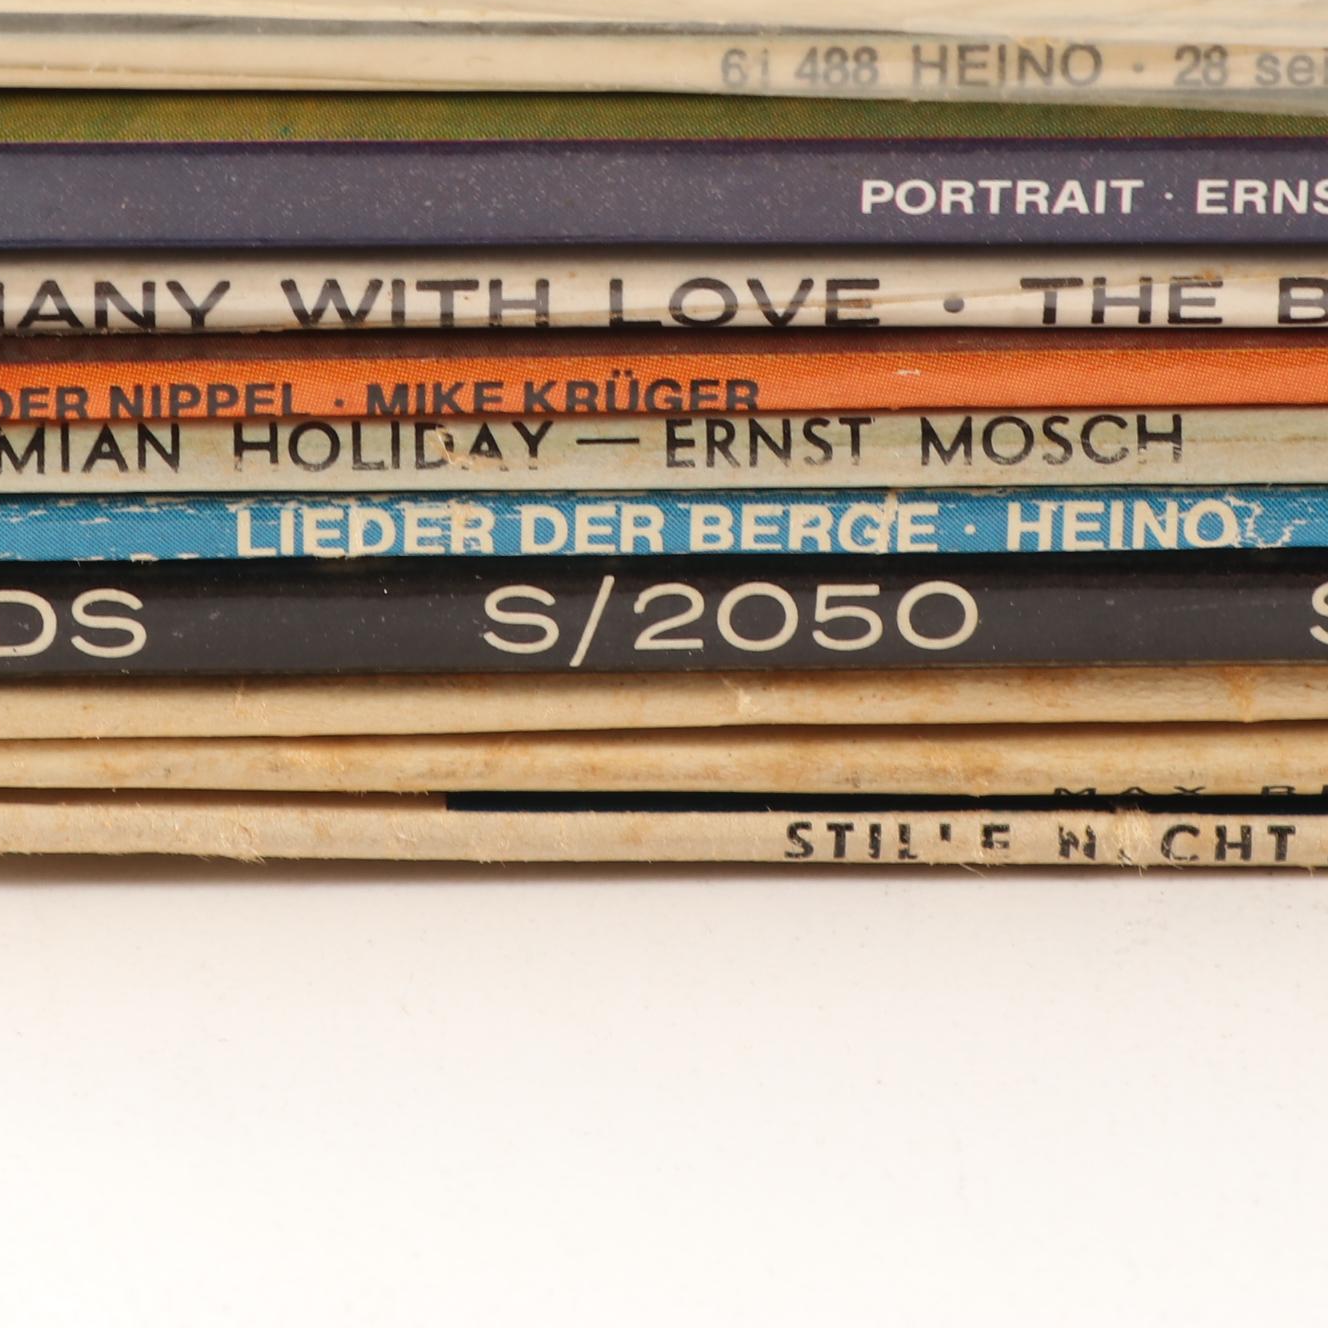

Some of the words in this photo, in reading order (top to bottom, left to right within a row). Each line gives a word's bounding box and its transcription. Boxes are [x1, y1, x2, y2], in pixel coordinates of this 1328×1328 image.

[910, 42, 1104, 88] HEINO
[1173, 42, 1231, 89] 28
[861, 178, 1145, 216] PORTRAIT
[280, 277, 551, 329] WITH
[608, 276, 881, 329] LOVE
[1019, 276, 1225, 326] THE
[108, 381, 312, 419] NIPPEL
[367, 378, 507, 417] MIKE
[523, 369, 761, 414] KRÜGER
[232, 419, 553, 473] HOLIDAY
[663, 415, 875, 471] ERNST
[919, 413, 1185, 469] MOSCH
[235, 503, 496, 559] LIEDER
[520, 502, 667, 556] DER
[689, 501, 940, 554] BERGE
[1007, 498, 1240, 552] HEINO
[482, 575, 980, 668] S/2050
